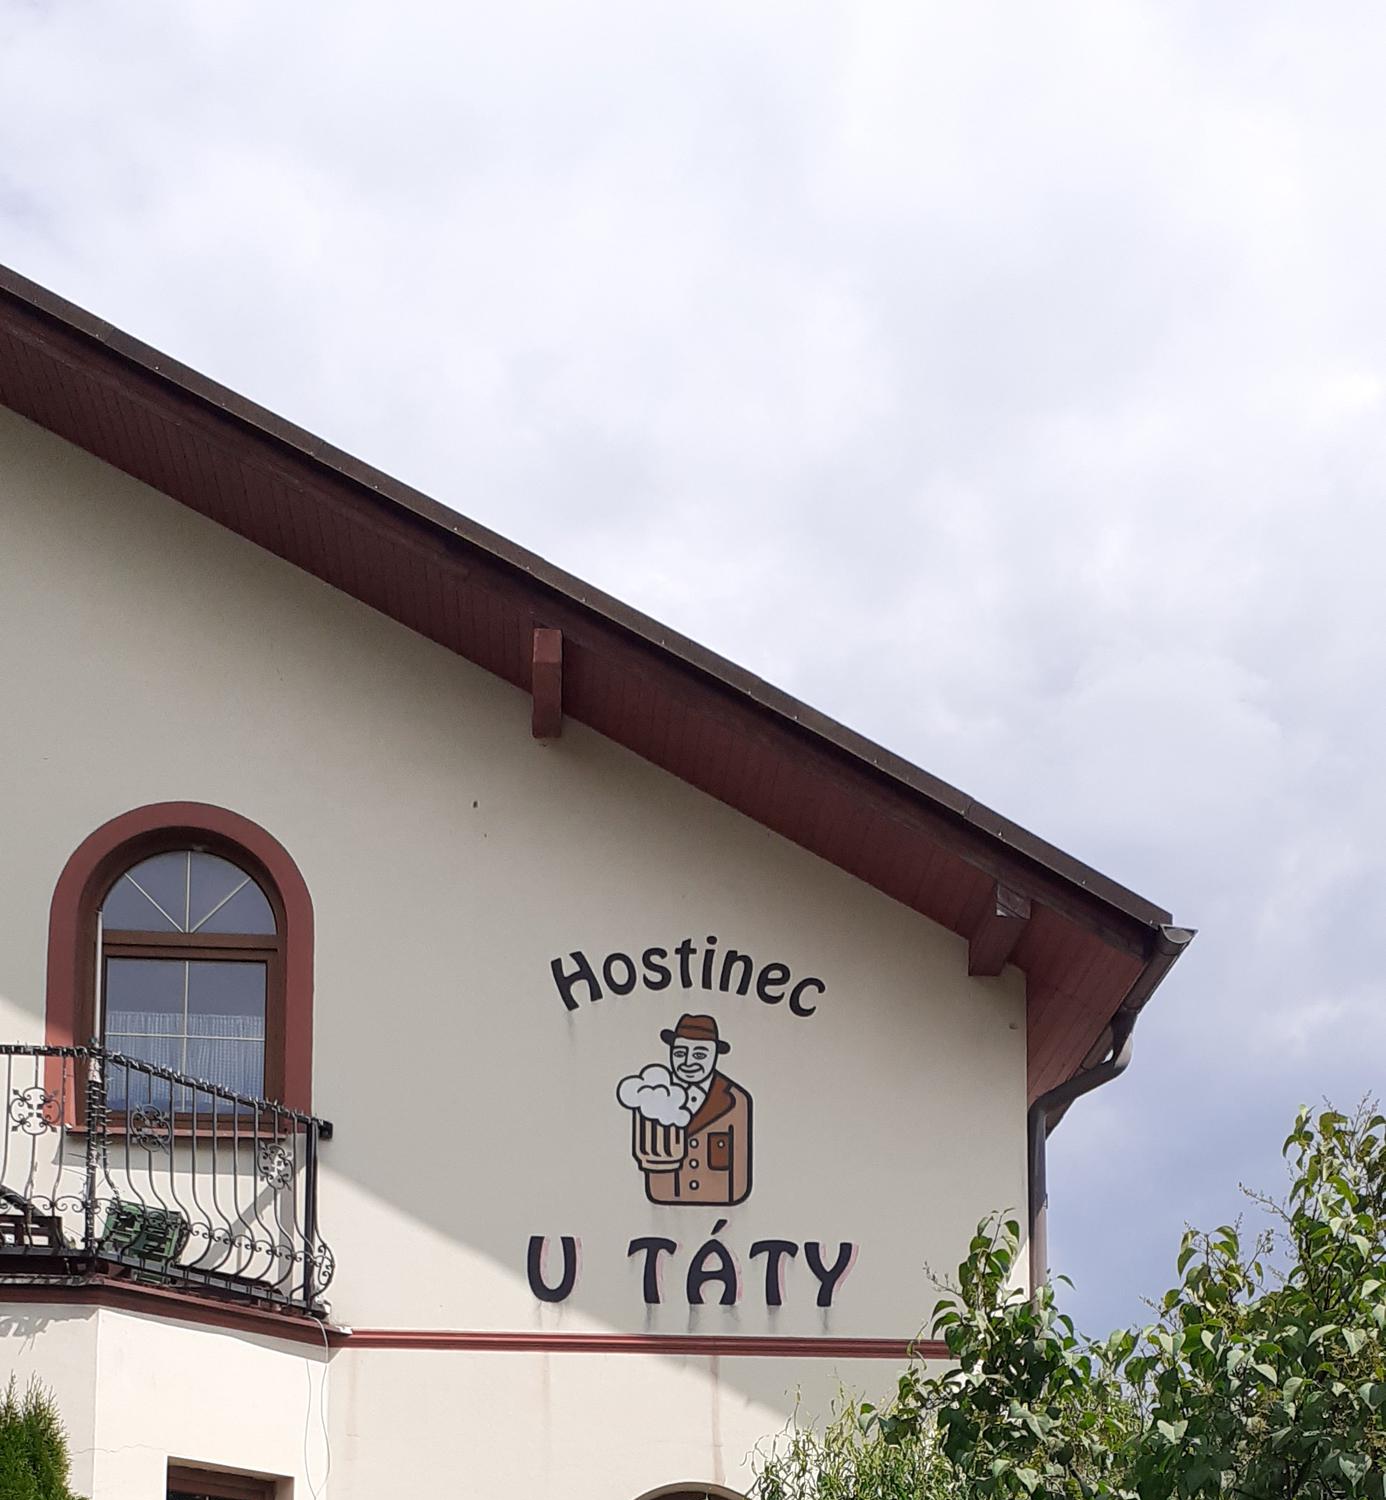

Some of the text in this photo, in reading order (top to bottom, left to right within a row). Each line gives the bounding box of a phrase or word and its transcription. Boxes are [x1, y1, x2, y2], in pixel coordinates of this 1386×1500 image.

[550, 935, 826, 1018] Hostinec
[527, 1218, 854, 1308] U TÁTY
